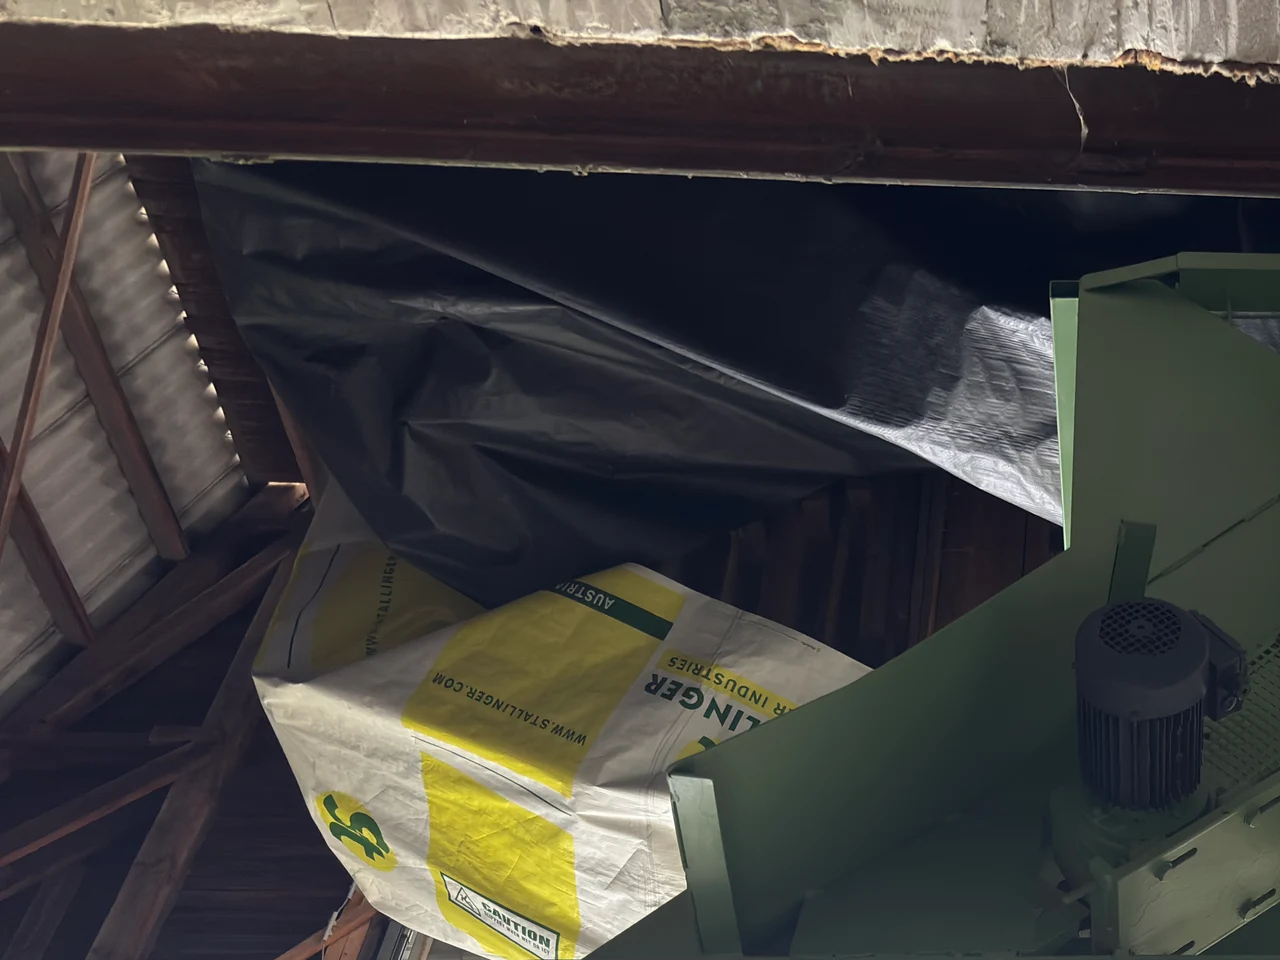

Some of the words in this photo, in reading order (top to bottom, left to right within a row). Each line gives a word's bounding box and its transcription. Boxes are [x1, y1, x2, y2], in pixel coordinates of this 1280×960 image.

[668, 657, 769, 708] INDUSTRIES
[432, 672, 587, 746] WWW.STALLINGER.COM
[481, 901, 551, 949] CAUTION
